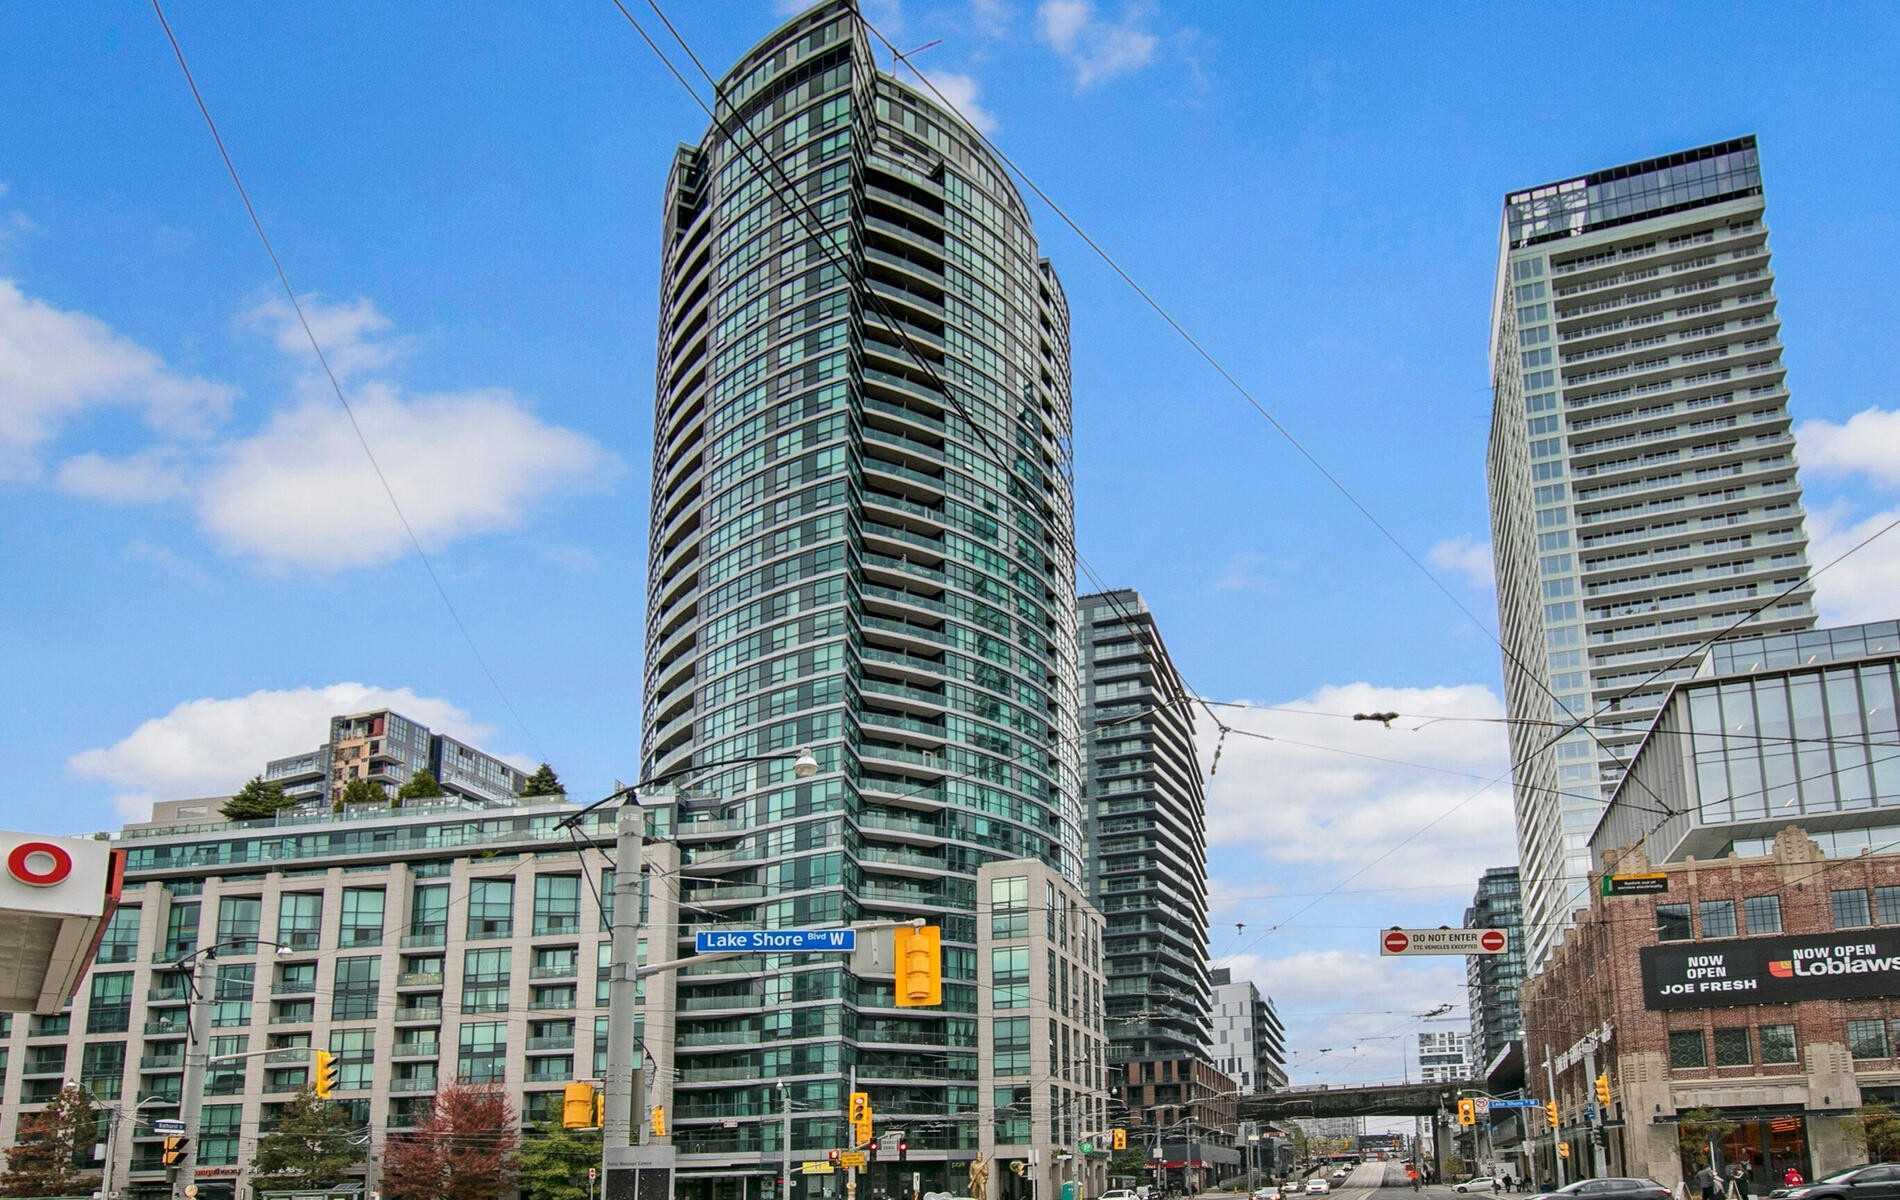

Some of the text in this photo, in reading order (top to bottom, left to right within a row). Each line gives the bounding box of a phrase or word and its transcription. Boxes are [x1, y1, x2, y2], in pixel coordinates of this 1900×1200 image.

[706, 932, 845, 947] Lake Shore Blvd W
[1412, 933, 1478, 942] DO NOT ENTER
[1793, 943, 1876, 960] NOW OPEN
[1688, 954, 1724, 967] NOW
[1686, 966, 1727, 979] OPEN
[1660, 979, 1758, 996] JOE FRESH
